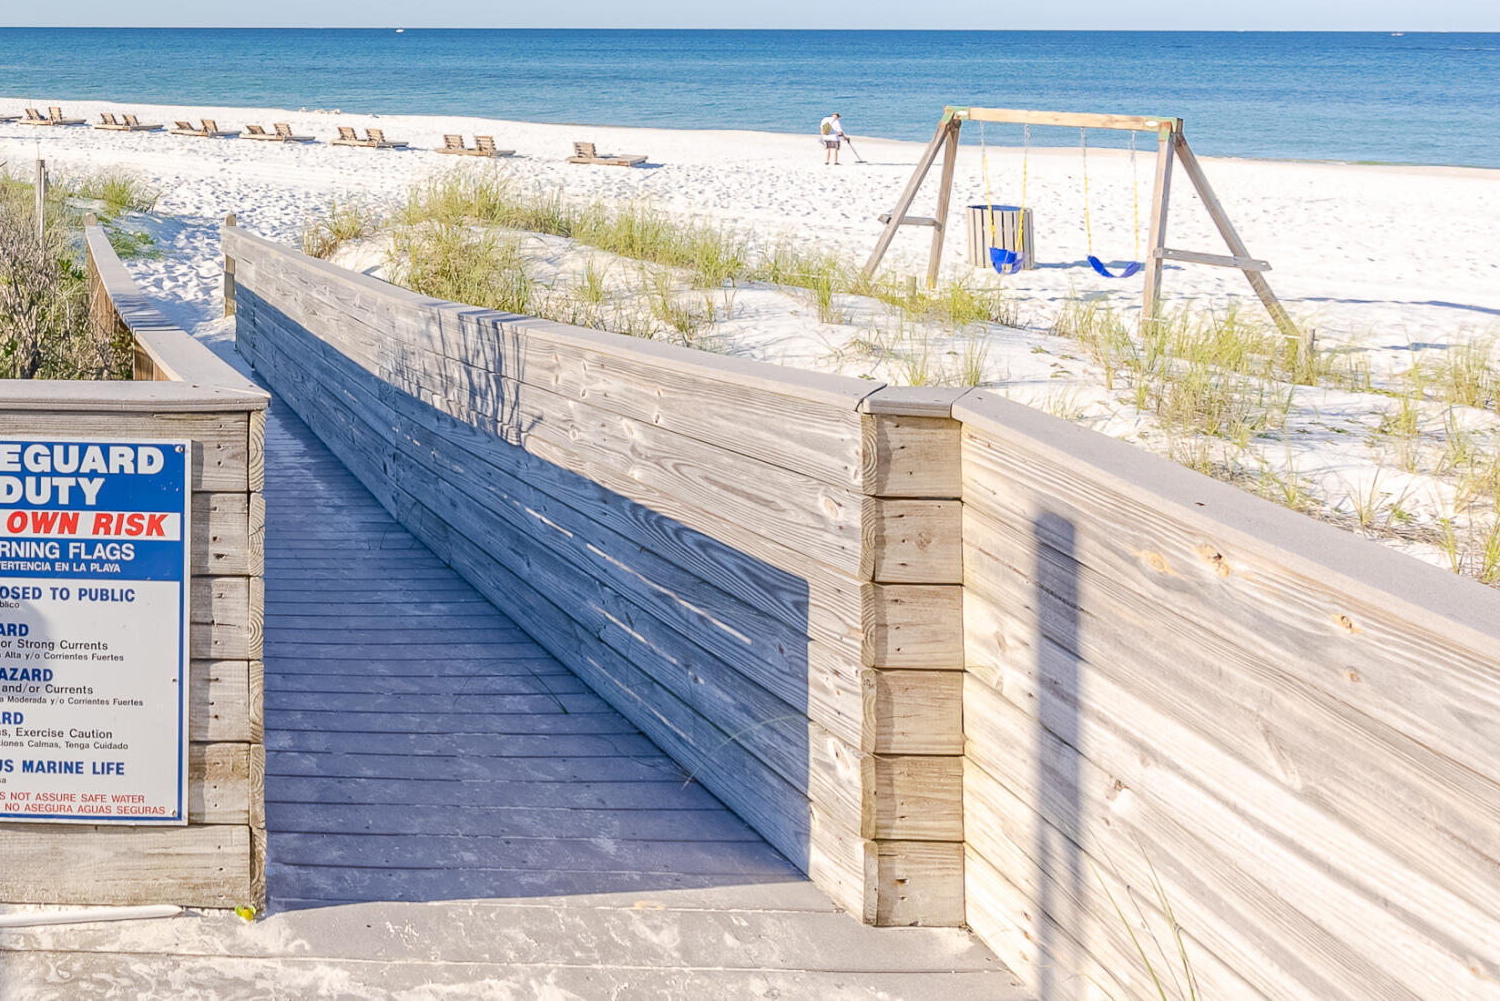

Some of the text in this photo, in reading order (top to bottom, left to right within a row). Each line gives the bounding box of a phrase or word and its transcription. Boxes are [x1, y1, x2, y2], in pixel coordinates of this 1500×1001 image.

[6, 511, 81, 534] OWN
[92, 513, 169, 536] RISK
[69, 543, 135, 561] FLAGS
[55, 562, 69, 571] EN
[73, 563, 87, 572] LA
[91, 563, 121, 572] PLAYA
[50, 587, 70, 600] TO
[78, 588, 135, 602] PUBLIC
[17, 640, 55, 650] Strong
[60, 640, 108, 650] Currents
[5, 651, 21, 659] Alta
[25, 652, 40, 660] y/o
[2, 683, 39, 693] and/or
[45, 684, 93, 694] Currents
[8, 696, 47, 704] Moderada
[50, 697, 64, 705] y/o
[68, 697, 109, 705] Corrientes
[16, 728, 64, 738] Exercise
[70, 729, 112, 739] Caution
[28, 740, 61, 748] Calmas,
[65, 741, 90, 750] Tenga
[94, 742, 128, 750] Cuidado
[23, 760, 84, 774] MARINE
[92, 762, 125, 775] LIFE
[10, 792, 32, 801] NOT
[35, 792, 76, 802] ASSURE
[81, 794, 106, 802] SAFE
[111, 794, 145, 803] WATER
[5, 803, 20, 811] NO
[25, 804, 72, 813] ASEGURA
[78, 805, 112, 814] AGUAS
[117, 806, 165, 815] SEGURAS
